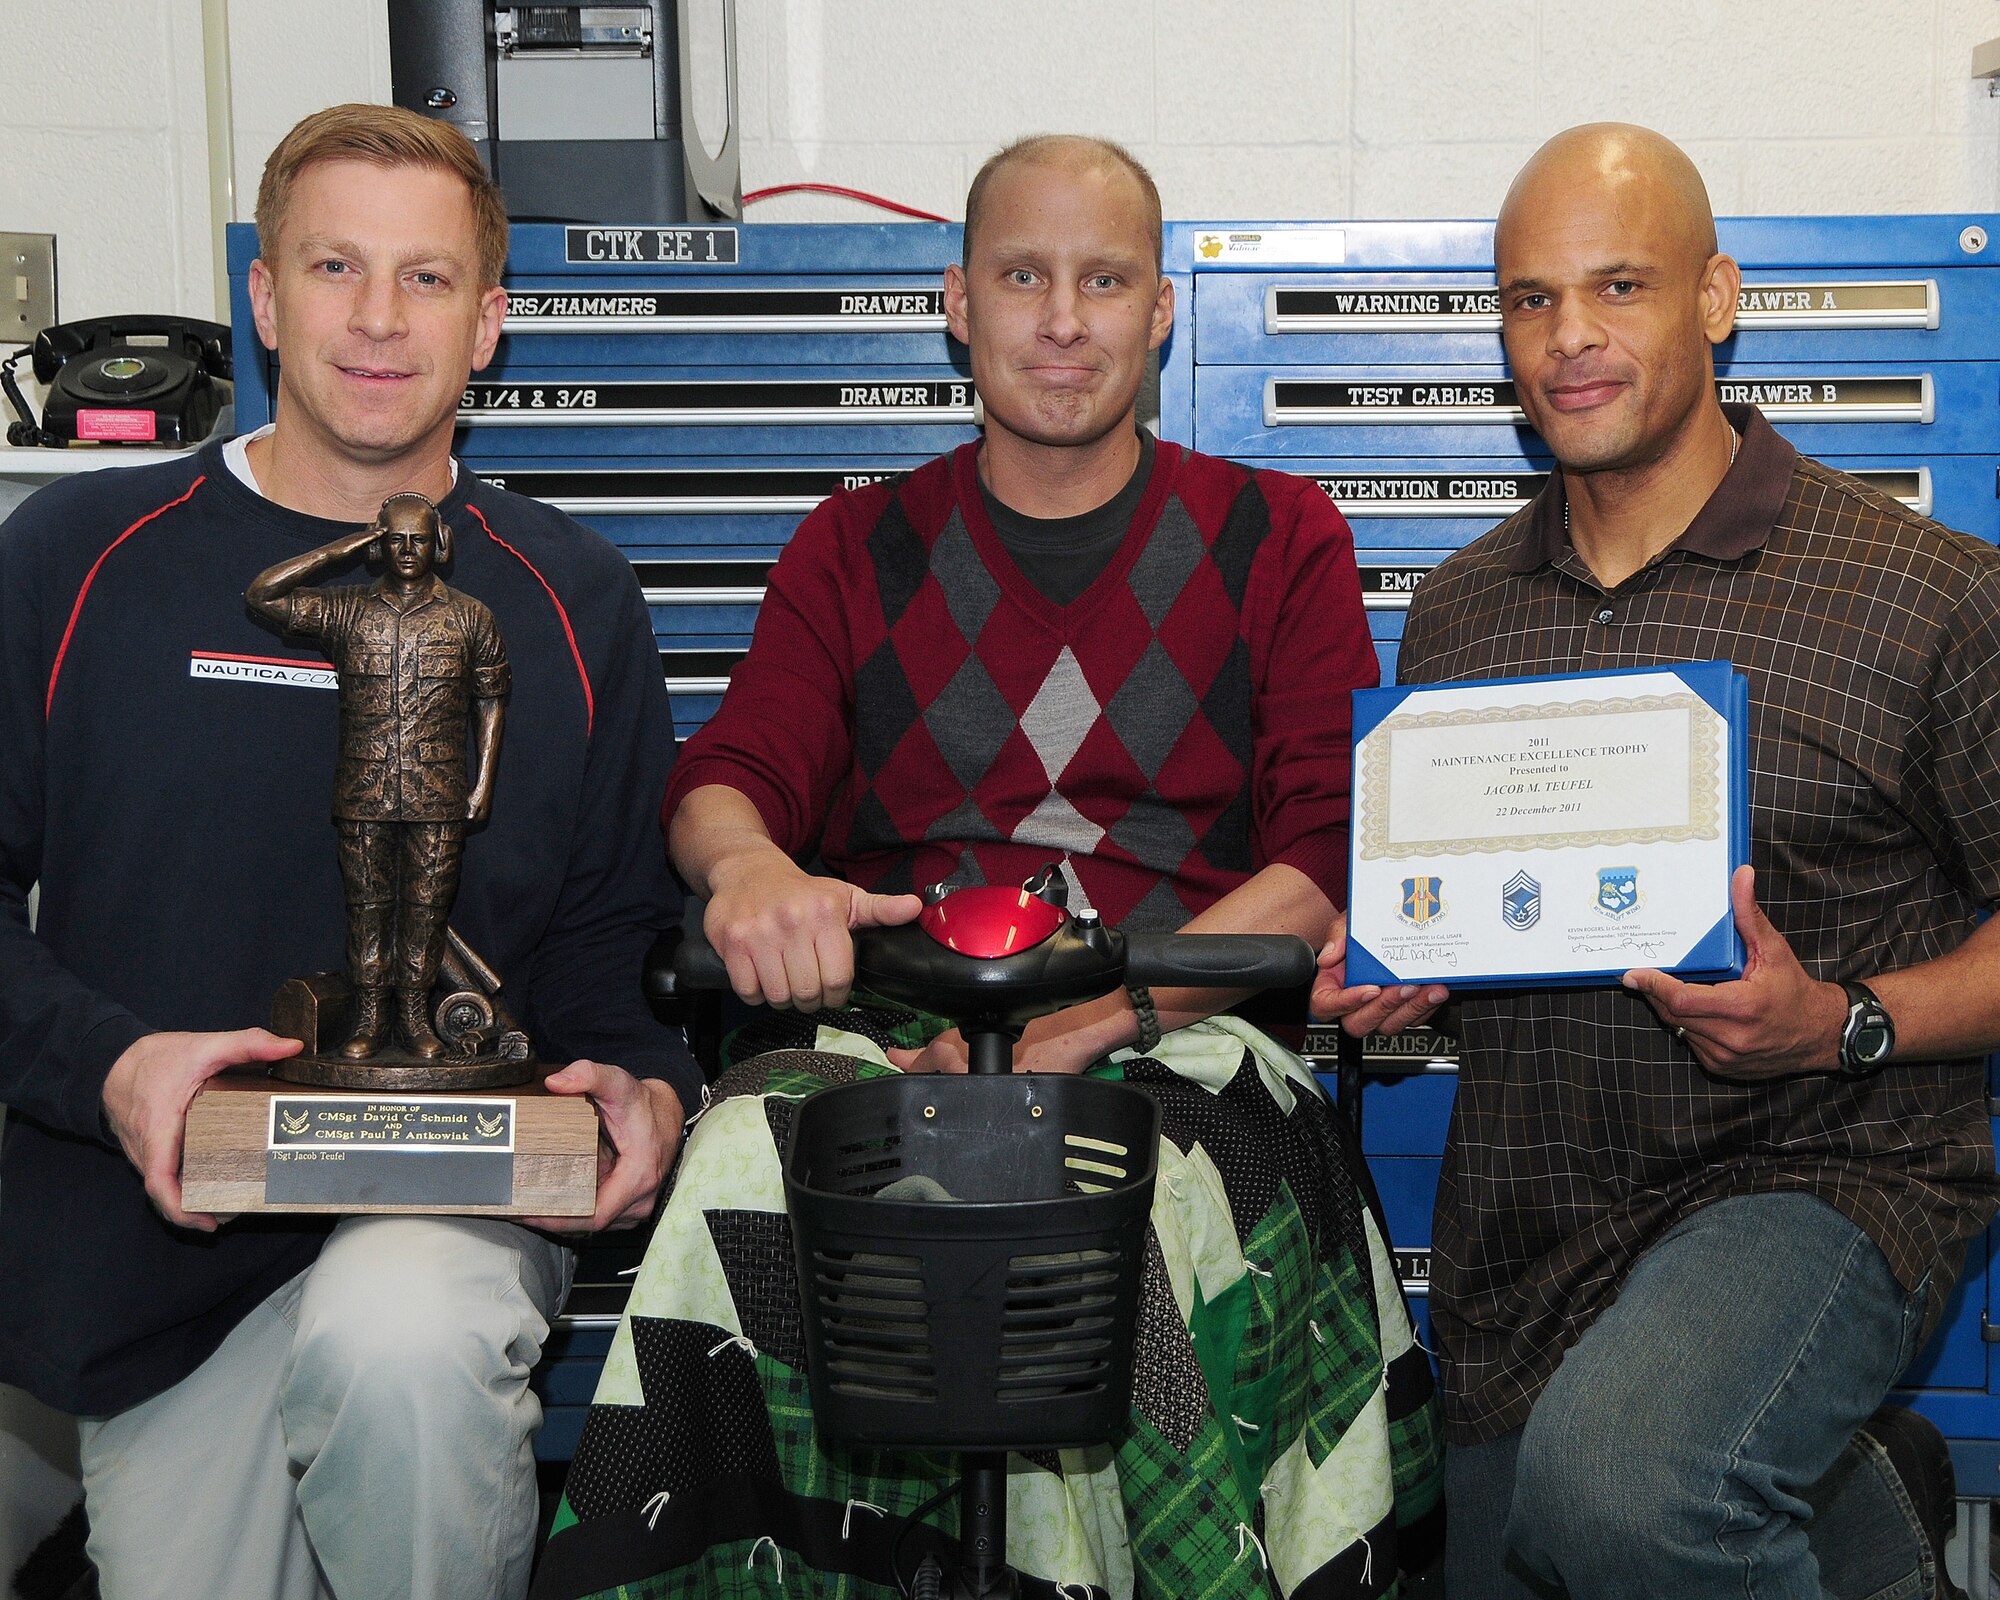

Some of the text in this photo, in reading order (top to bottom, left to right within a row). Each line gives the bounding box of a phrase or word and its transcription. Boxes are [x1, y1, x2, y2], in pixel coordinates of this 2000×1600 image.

[586, 230, 718, 261] CTK EE 1
[840, 296, 928, 314] DRAWER
[1335, 291, 1837, 313] WARNING TAGS RAWER A
[483, 390, 520, 408] 1/4
[531, 390, 545, 408] &
[556, 390, 597, 408] 3/8
[840, 387, 928, 405] DRAWER
[949, 385, 966, 406] B
[1348, 384, 1837, 405] TEST CABLES DRAWER B
[1317, 480, 1518, 498] EXTENTION CORDS
[196, 664, 287, 680] NAUTICA
[1528, 738, 1549, 747] 2011
[1431, 744, 1648, 767] MAINTENANCE EXCELLENCE TROPHY
[1509, 764, 1569, 775] Presented to
[1483, 779, 1593, 796] JACOB M. TEUFEL
[1496, 803, 1581, 816] 22 December 2011
[318, 1112, 468, 1123] CMSgt David C. Schmidt
[315, 1130, 354, 1140] CMSgt
[360, 1130, 386, 1139] Paul
[392, 1131, 400, 1139] P.
[405, 1131, 469, 1140] Antkowiak
[272, 1150, 345, 1161] TSgt Jacob Teufel
